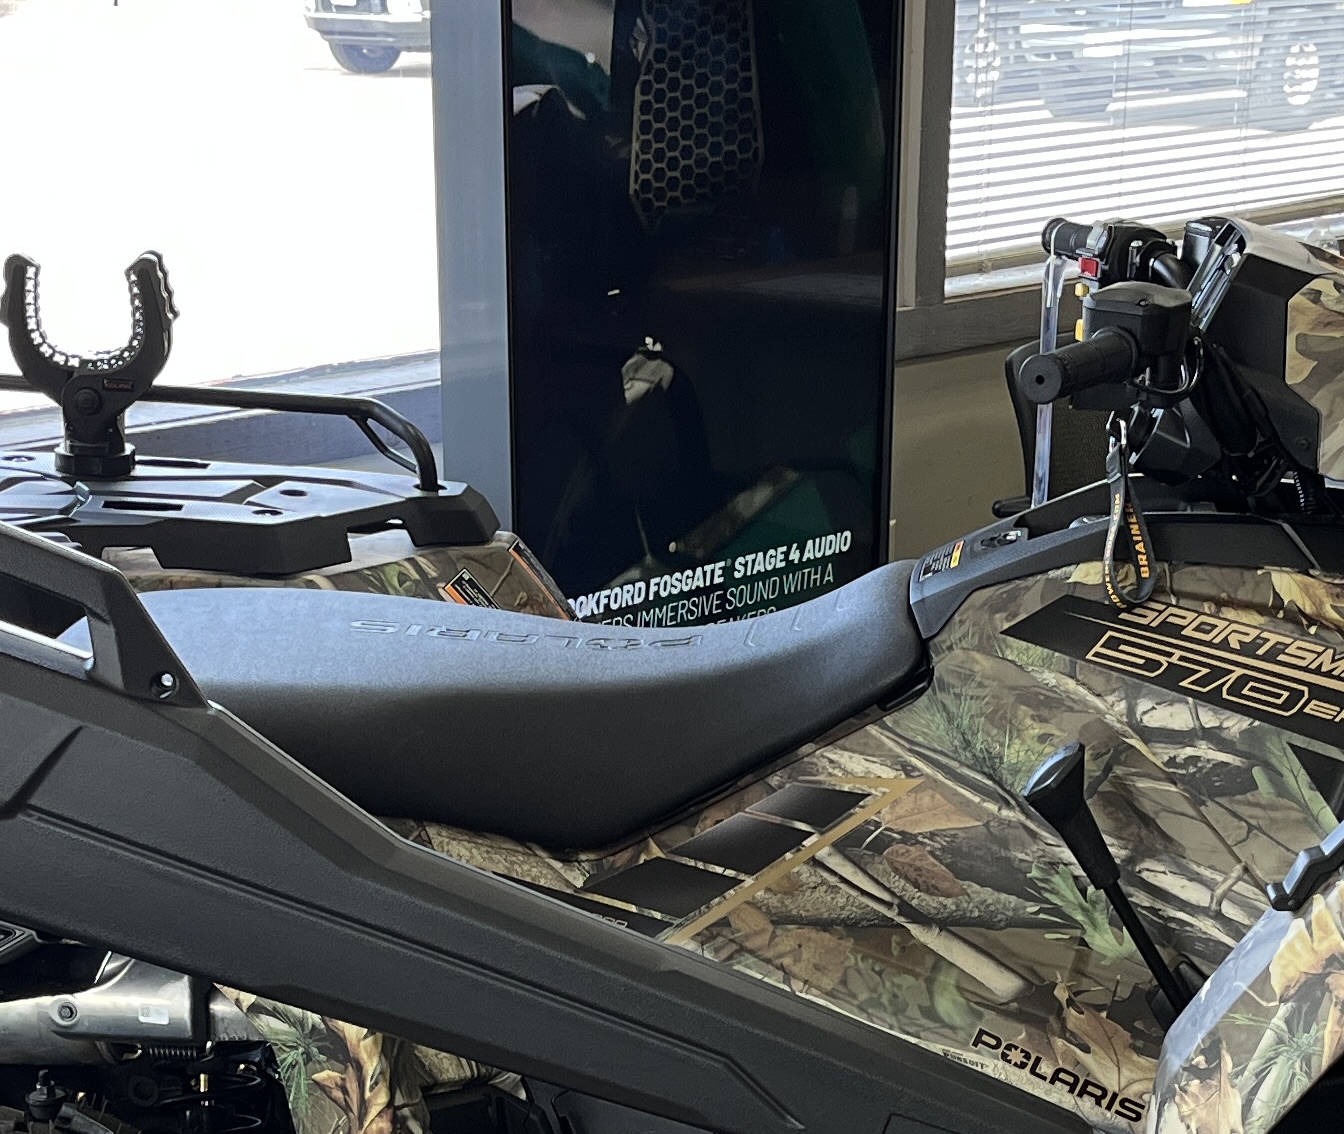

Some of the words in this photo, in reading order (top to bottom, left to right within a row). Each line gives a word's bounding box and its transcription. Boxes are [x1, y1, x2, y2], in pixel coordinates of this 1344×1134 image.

[567, 582, 646, 619] OCKFORD
[734, 546, 787, 578] STAGE
[788, 542, 800, 564] 4
[802, 530, 852, 561] AUDIO
[1124, 501, 1149, 578] BRAINER
[349, 618, 704, 651] POLARIS
[633, 591, 723, 628] IMMERSIVE
[726, 576, 780, 607] SOUND
[782, 565, 820, 594] WITH
[822, 562, 835, 583] A
[1086, 630, 1309, 717] 570
[971, 1028, 1146, 1123] POLARIS
